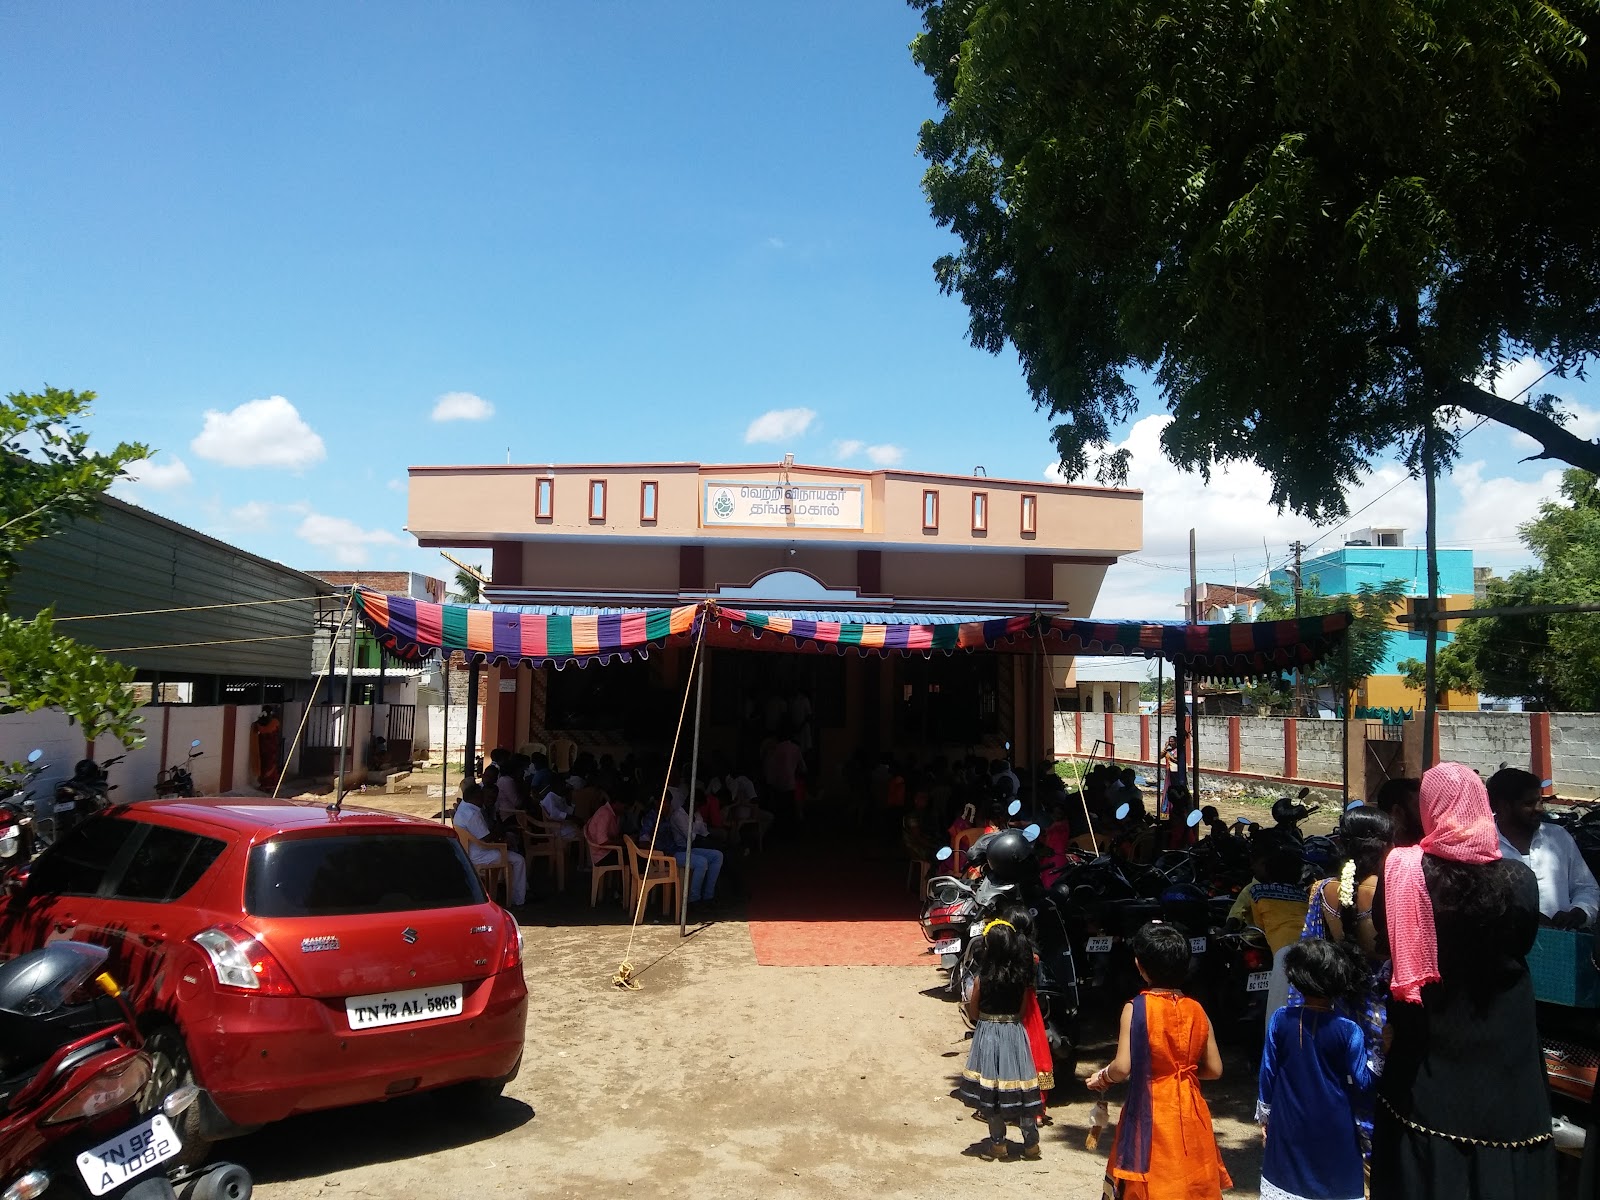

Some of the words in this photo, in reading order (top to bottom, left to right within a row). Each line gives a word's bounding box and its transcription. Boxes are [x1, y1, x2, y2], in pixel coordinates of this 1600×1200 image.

[740, 486, 783, 501] வெற்றி
[784, 487, 847, 502] விநாயகர்
[749, 501, 793, 516] தங்க
[794, 502, 840, 516] மகால்
[355, 1005, 379, 1022] TN
[382, 1003, 397, 1019] 72
[401, 1000, 423, 1017] AL
[427, 995, 457, 1012] 5868
[98, 1143, 126, 1168] TN
[130, 1128, 156, 1152] 92
[101, 1171, 115, 1190] A
[120, 1139, 171, 1176] 1082
